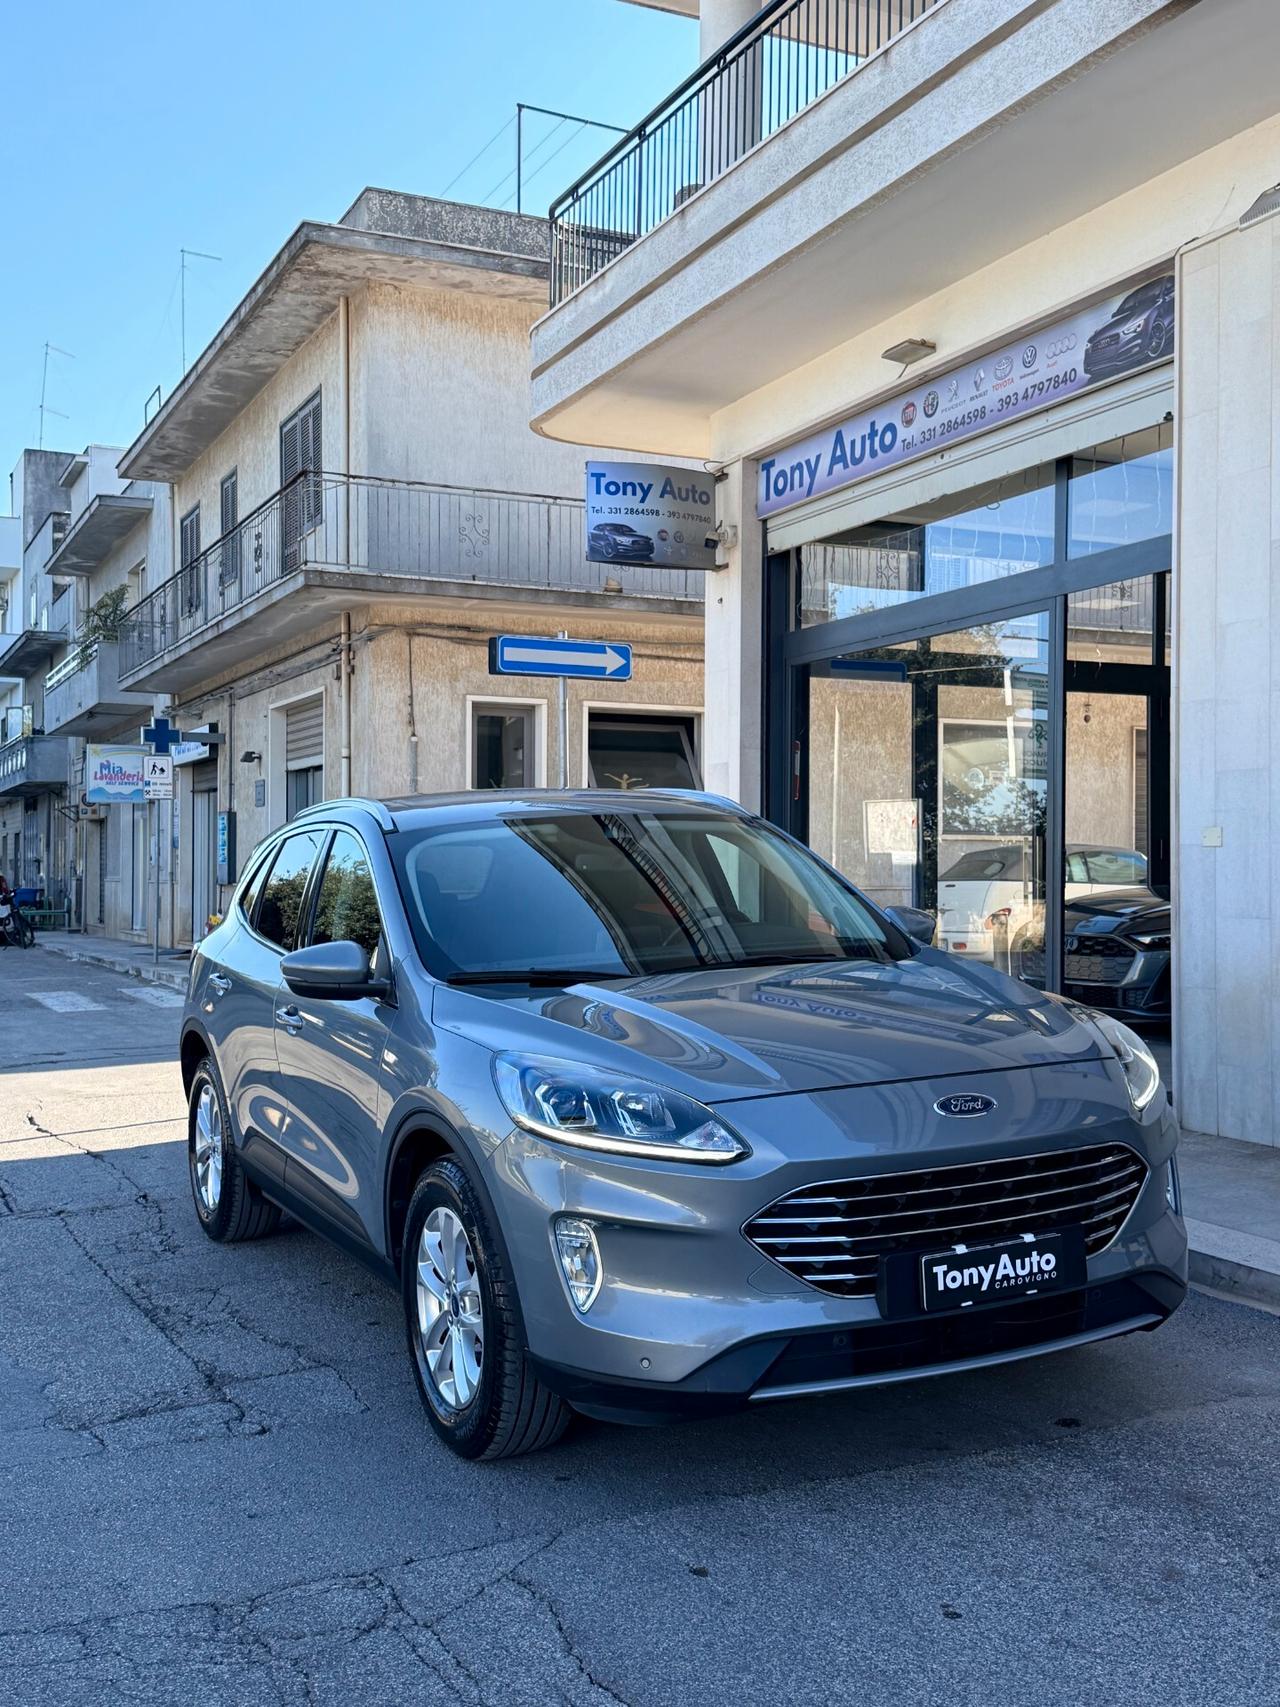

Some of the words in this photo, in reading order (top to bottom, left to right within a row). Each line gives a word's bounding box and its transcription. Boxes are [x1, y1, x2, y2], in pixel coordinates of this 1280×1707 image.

[992, 377, 1014, 391] TOYOTA
[901, 435, 917, 452] Tel.
[920, 427, 936, 444] 331
[940, 405, 986, 435] 2864598
[997, 392, 1019, 412] 393
[1021, 368, 1077, 401] 4797840
[761, 453, 822, 501] Tony
[827, 420, 898, 477] Auto
[590, 472, 654, 504] Tony
[659, 476, 711, 505] Auto
[591, 506, 605, 515] Tel.
[608, 507, 621, 515] 331
[624, 507, 660, 517] 2864598
[667, 510, 680, 519] 393
[94, 767, 144, 782] Lavanderia
[99, 760, 124, 774] Mia
[951, 1096, 984, 1112] Ford
[933, 1251, 1056, 1292] TonyAuto
[995, 1271, 1057, 1289] CAROVIGNO
